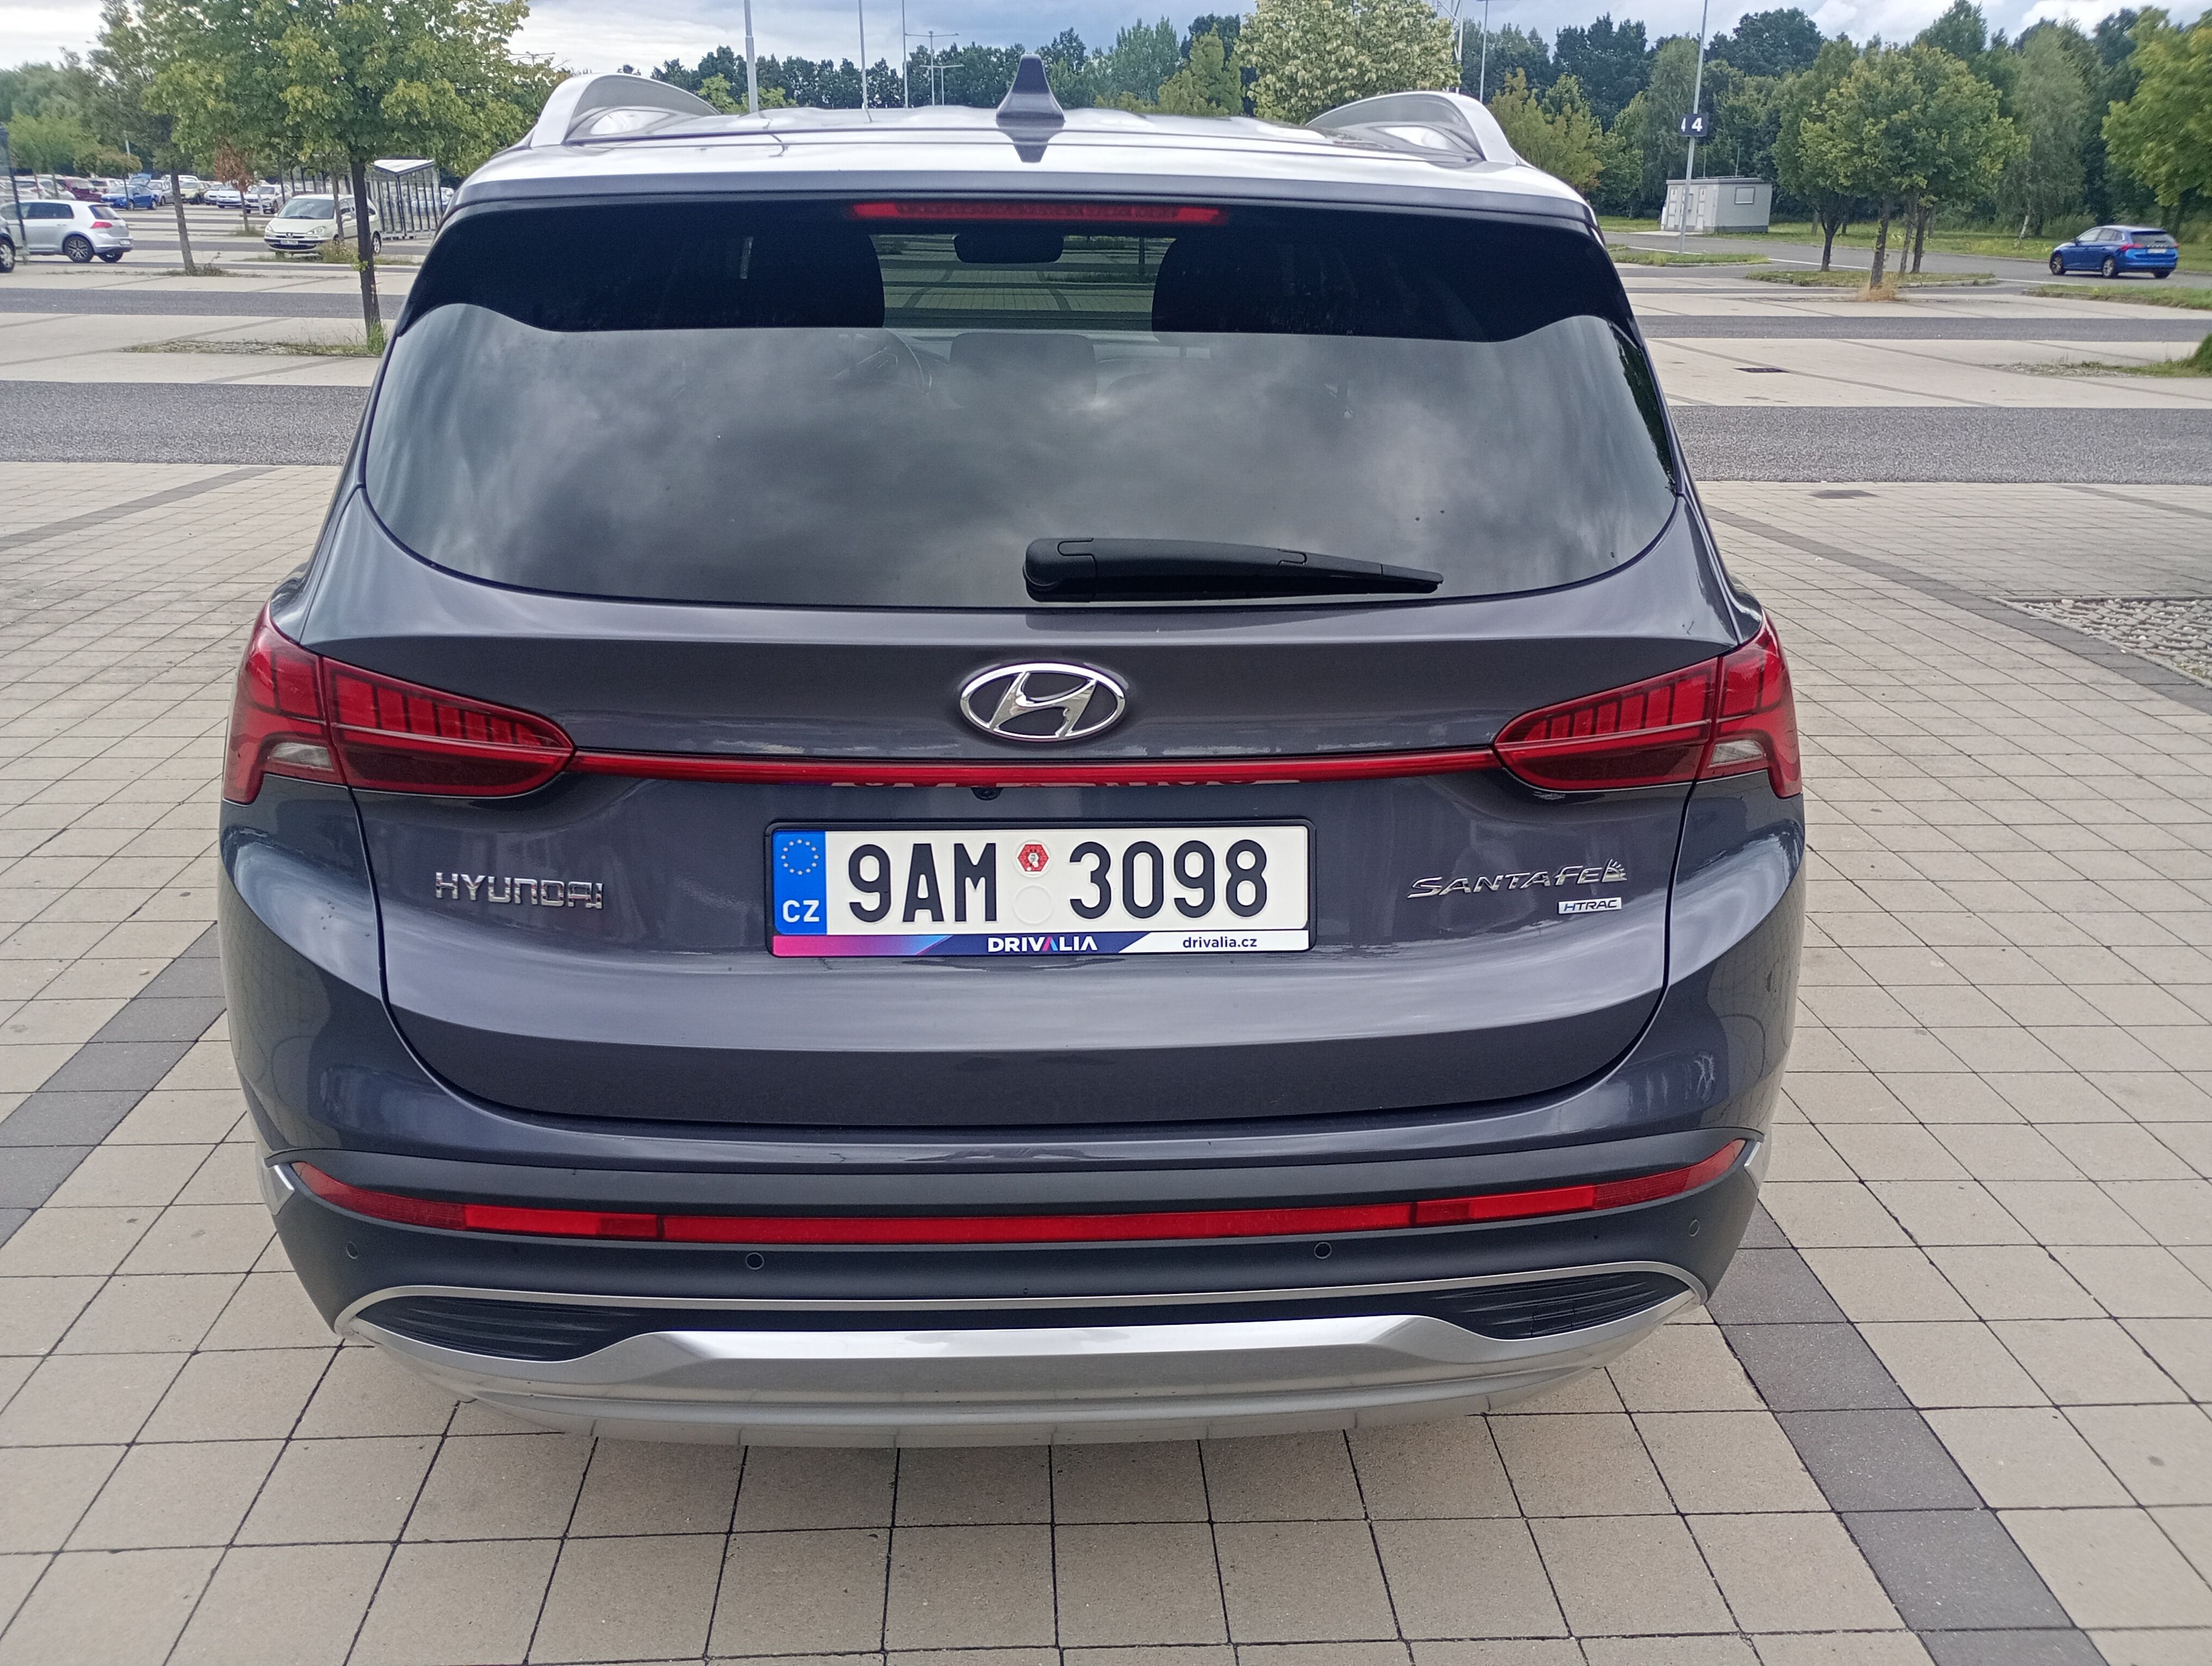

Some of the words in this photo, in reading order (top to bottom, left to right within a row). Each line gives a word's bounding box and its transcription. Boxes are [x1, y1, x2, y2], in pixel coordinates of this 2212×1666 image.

[1692, 117, 1703, 132] 4
[848, 842, 996, 922] 9AM
[1069, 839, 1268, 919] 3098
[435, 872, 603, 909] HYUNDAI
[782, 899, 820, 922] CZ
[1564, 899, 1618, 912] HTRAC
[987, 936, 1098, 952] DRIVALIA
[1182, 937, 1258, 948] drivalia.cz
